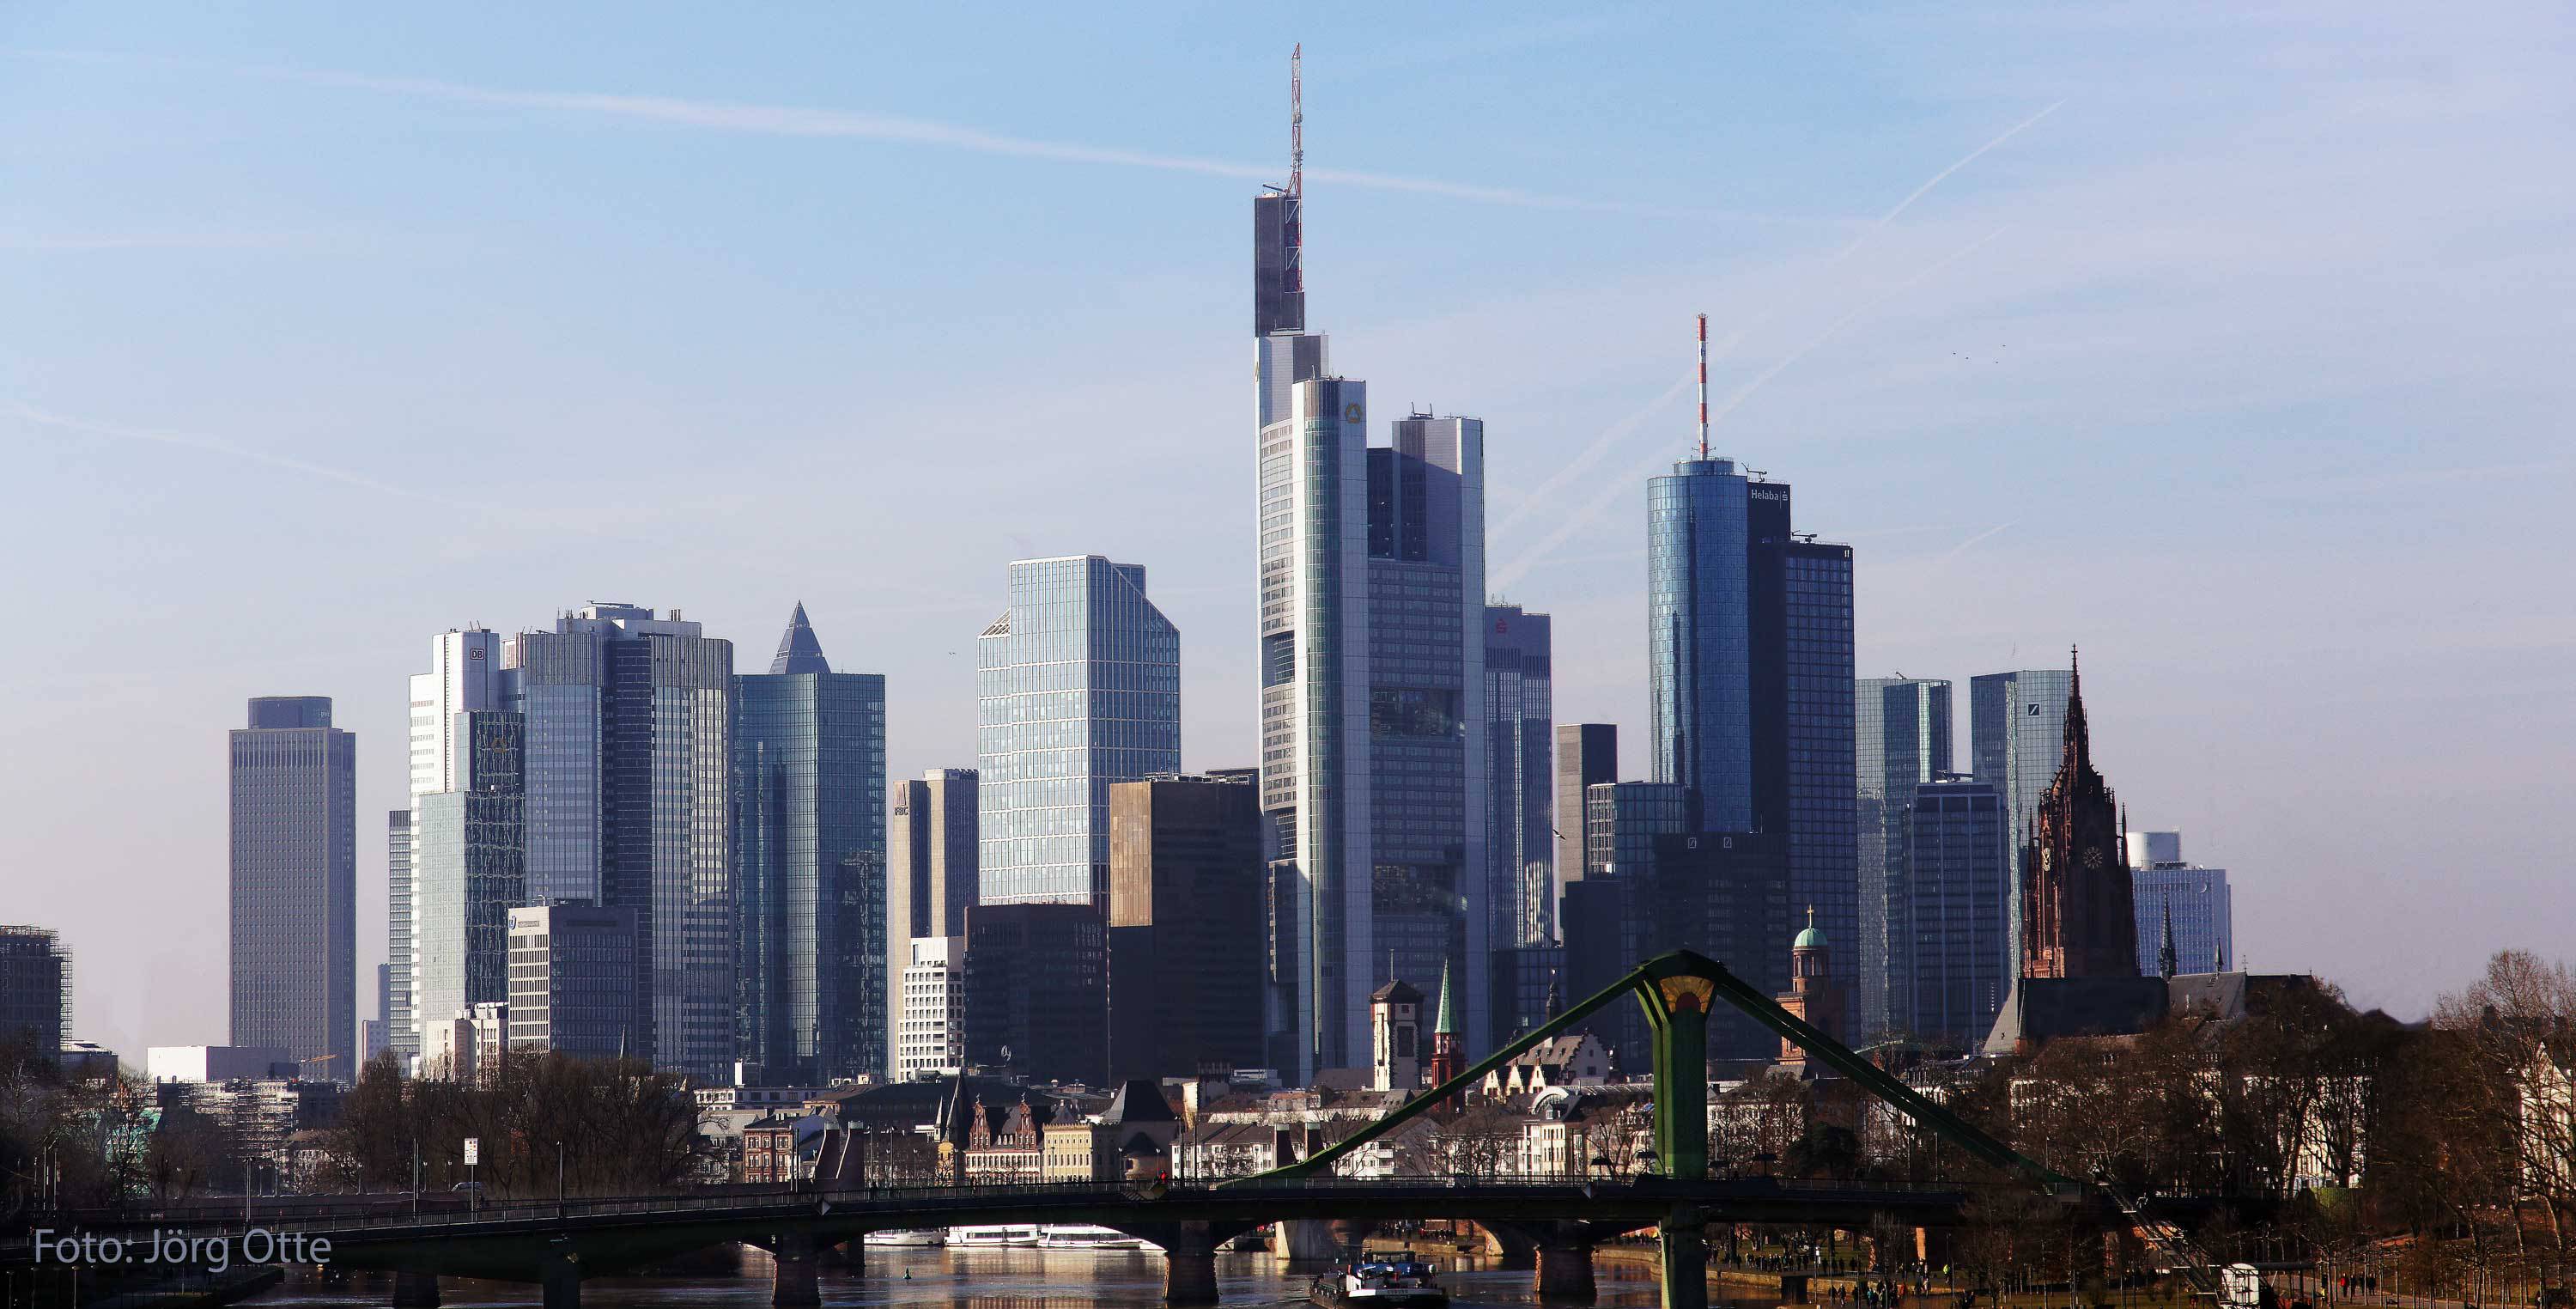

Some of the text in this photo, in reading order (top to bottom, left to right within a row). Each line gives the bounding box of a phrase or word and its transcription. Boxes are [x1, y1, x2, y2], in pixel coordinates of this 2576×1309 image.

[1752, 489, 1779, 501] Helaba
[471, 649, 483, 659] DB
[894, 807, 908, 816] FBC
